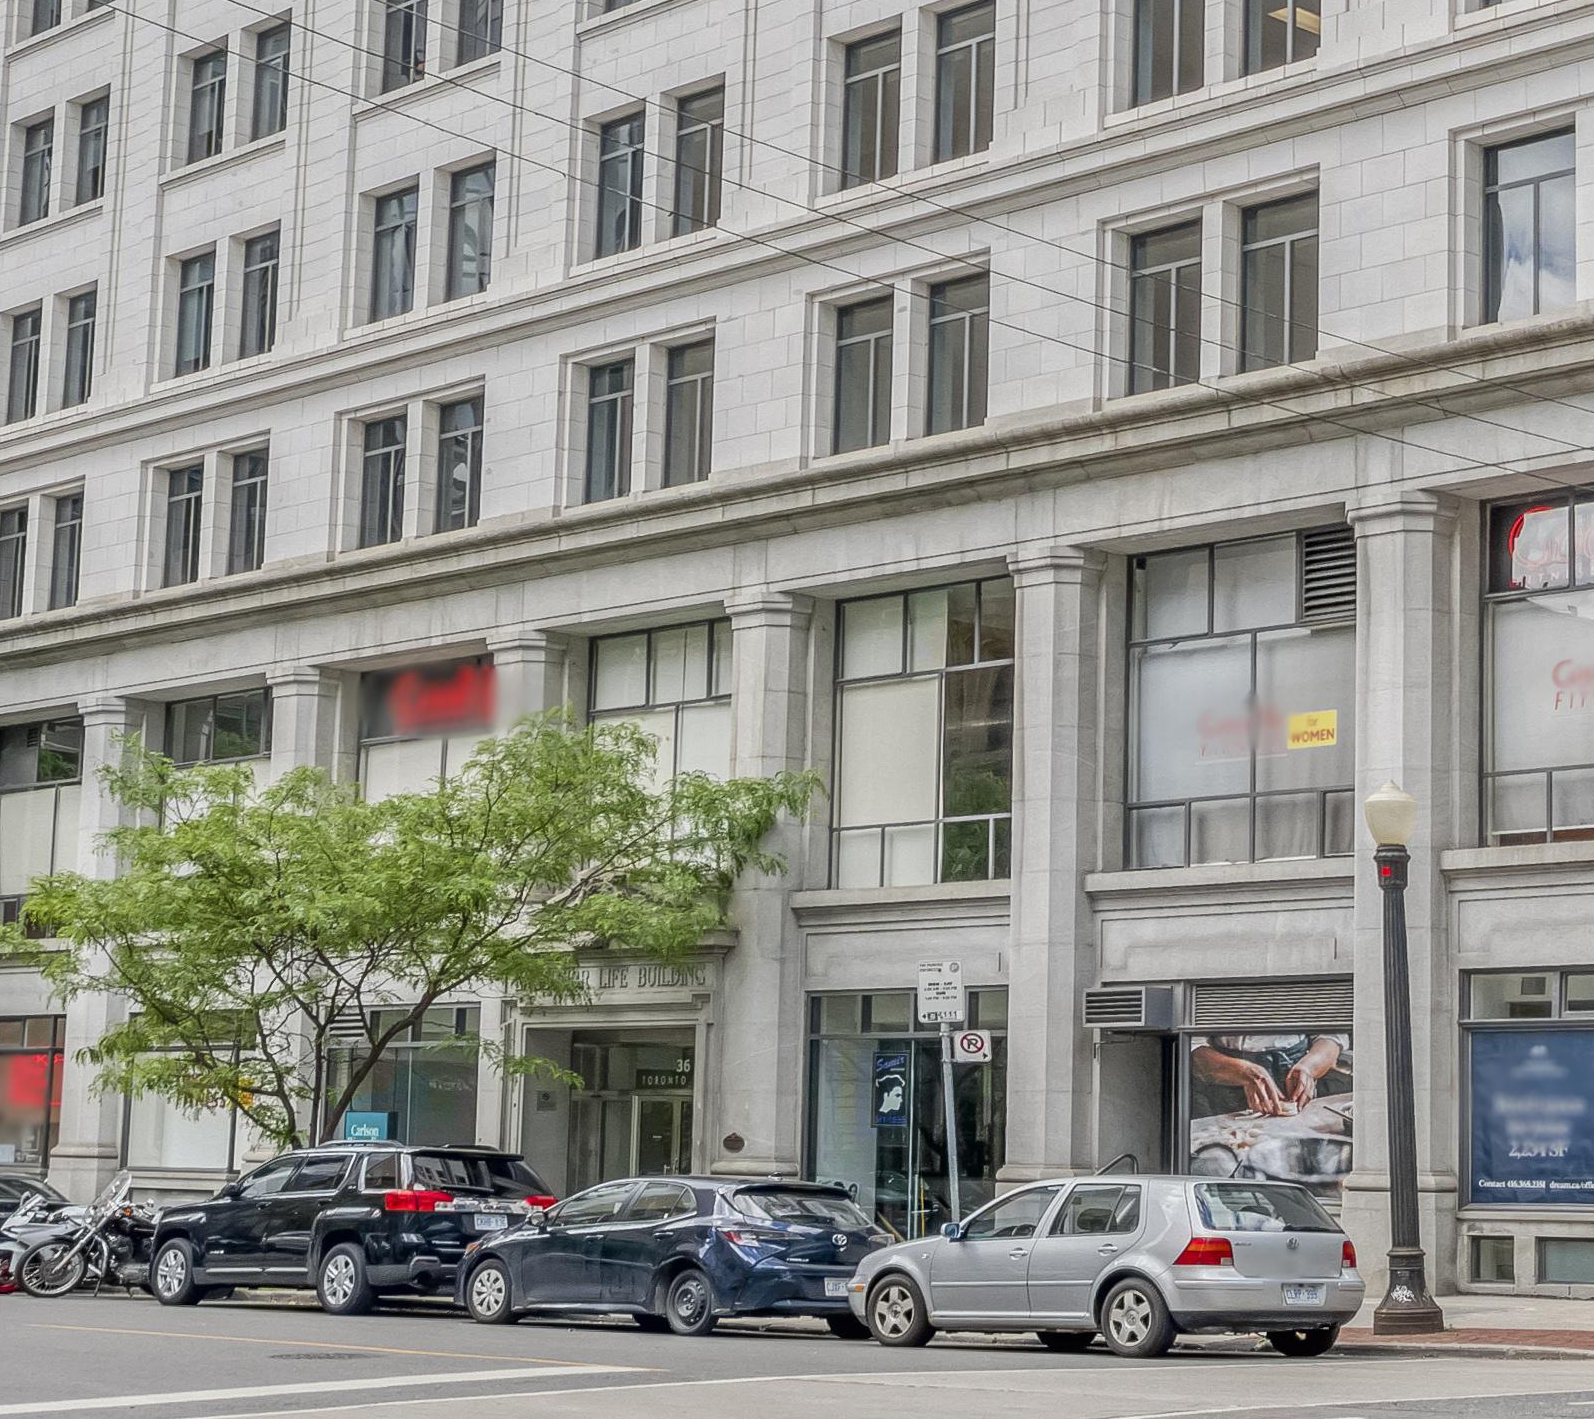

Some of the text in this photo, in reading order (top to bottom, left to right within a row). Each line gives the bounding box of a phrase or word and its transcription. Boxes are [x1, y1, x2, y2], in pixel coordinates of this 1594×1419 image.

[1291, 728, 1334, 744] WOMEN
[599, 968, 628, 989] LIFE
[638, 965, 705, 988] BUILDING
[676, 1059, 691, 1073] 36
[642, 1075, 687, 1086] TORONTO
[350, 1124, 379, 1137] Carlson
[1478, 1179, 1506, 1188] Contact
